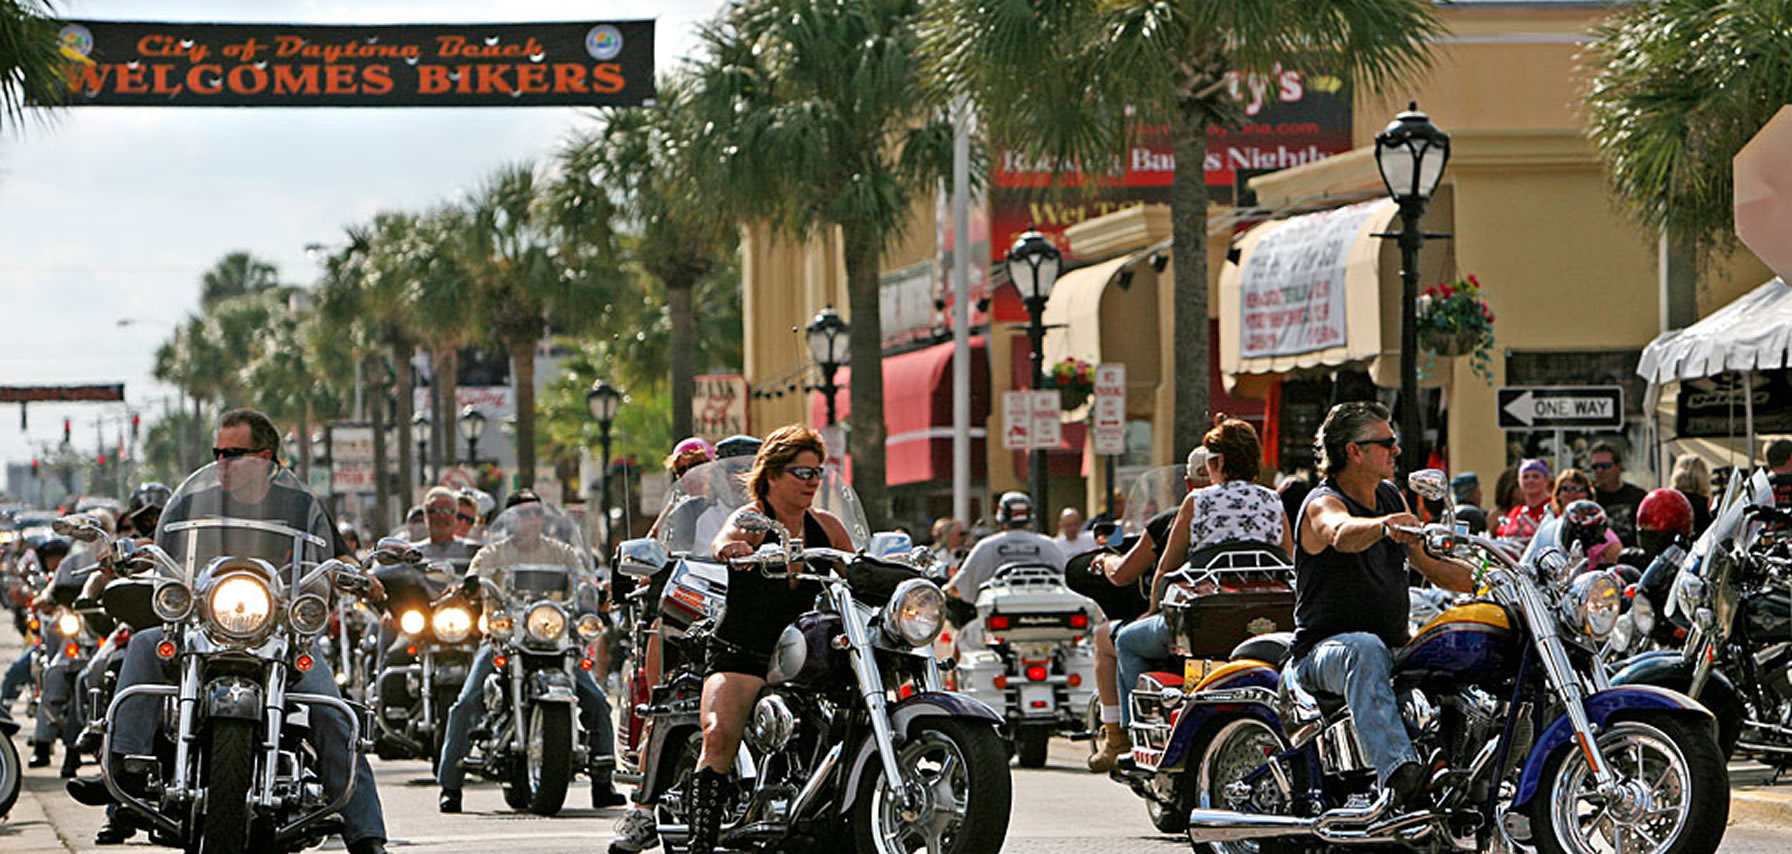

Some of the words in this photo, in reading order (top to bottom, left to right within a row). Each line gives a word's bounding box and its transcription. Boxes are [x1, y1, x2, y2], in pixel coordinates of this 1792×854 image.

[138, 35, 207, 62] City
[223, 38, 267, 61] of
[275, 36, 420, 62] Daytona
[436, 34, 546, 57] Beach
[67, 60, 394, 95] WELCOMES
[417, 62, 625, 94] BIKERS
[1131, 147, 1221, 171] Bans
[1228, 145, 1335, 170] Nightl
[1535, 400, 1569, 416] ONE
[1574, 400, 1609, 416] WAY
